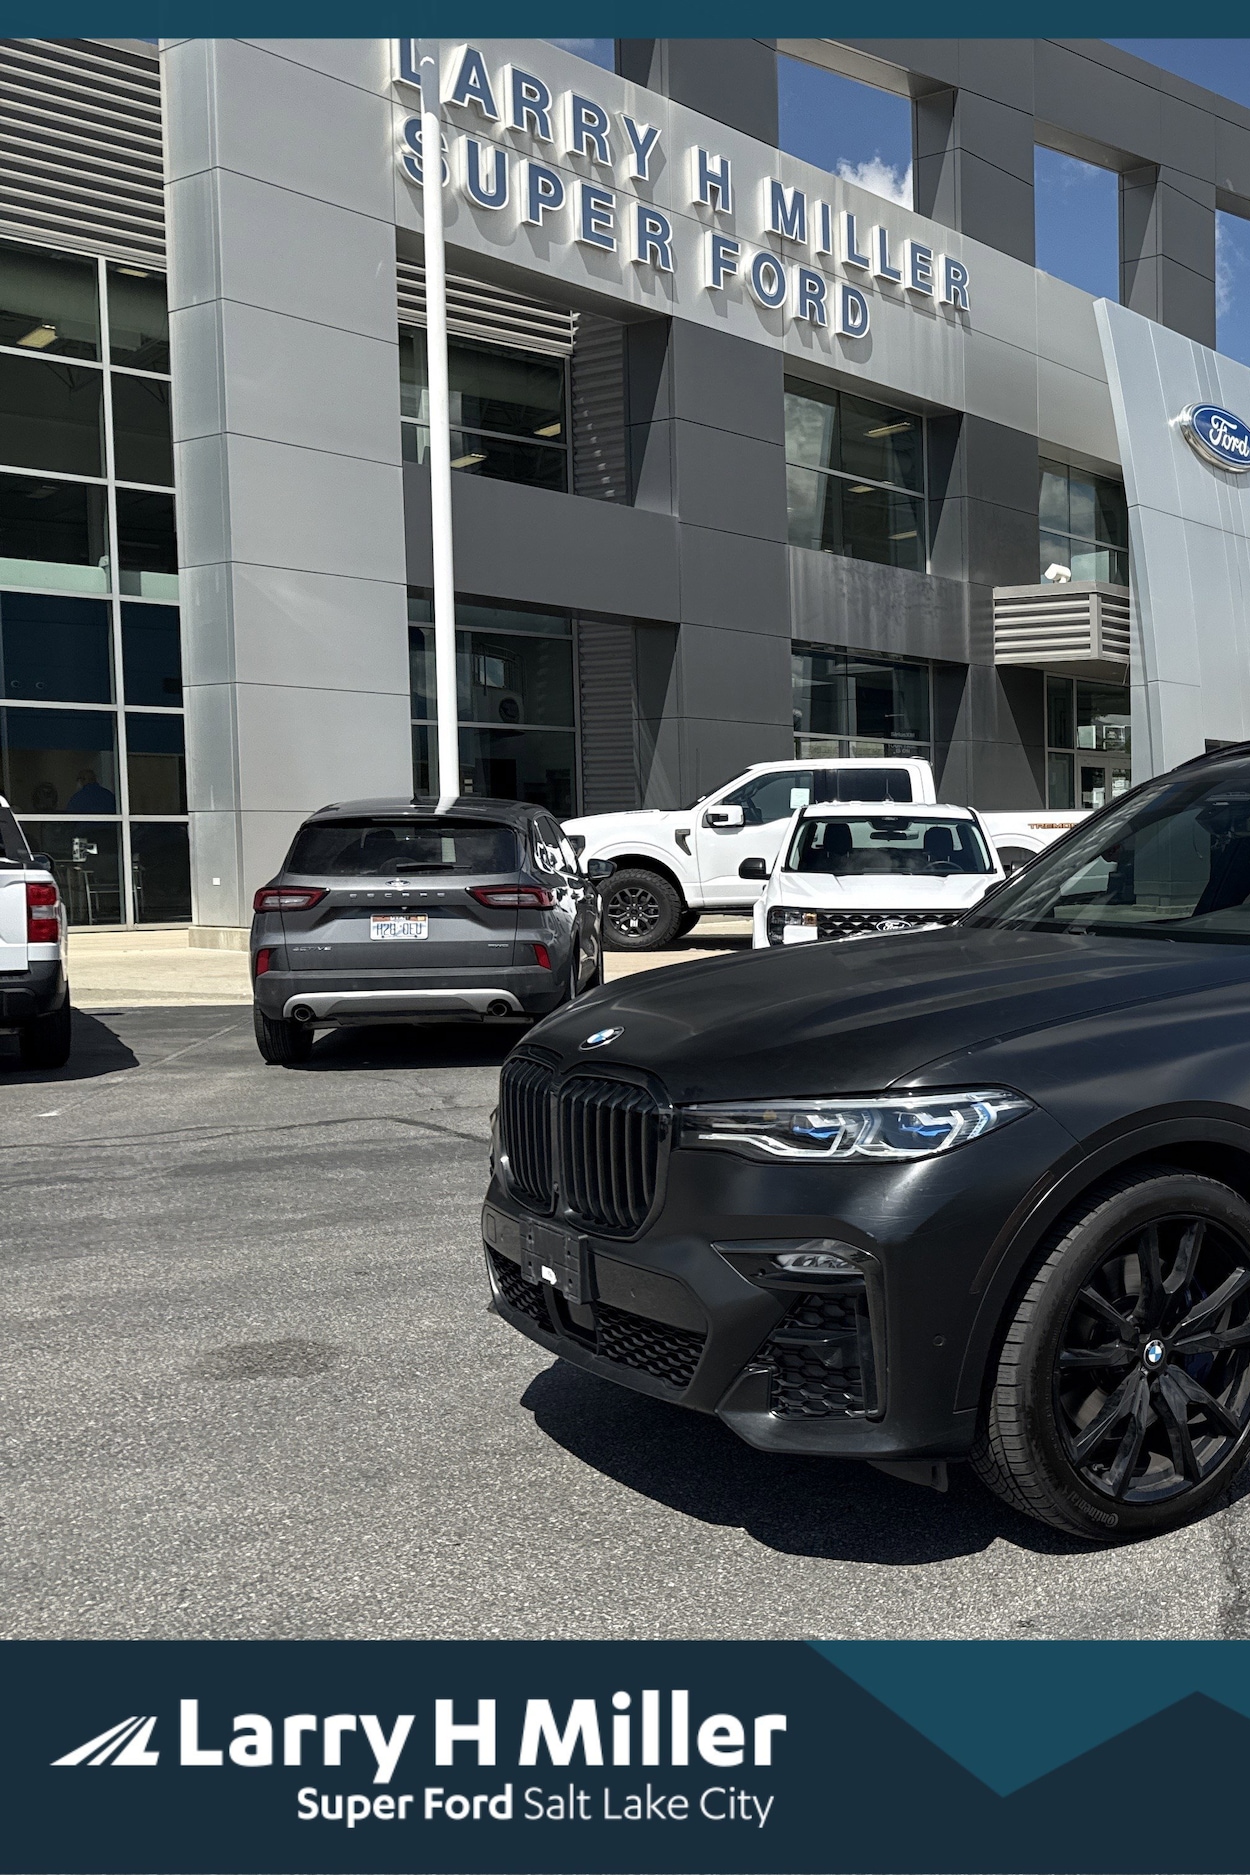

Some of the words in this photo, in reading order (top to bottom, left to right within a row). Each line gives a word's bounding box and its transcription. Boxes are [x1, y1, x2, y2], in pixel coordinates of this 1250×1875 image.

[393, 38, 662, 182] LARRY
[691, 145, 733, 214] H
[763, 176, 971, 312] MILLER
[399, 115, 674, 274] SUPER
[704, 230, 871, 339] FORD
[1208, 414, 1250, 457] Ford
[1066, 1491, 1119, 1528] Continental
